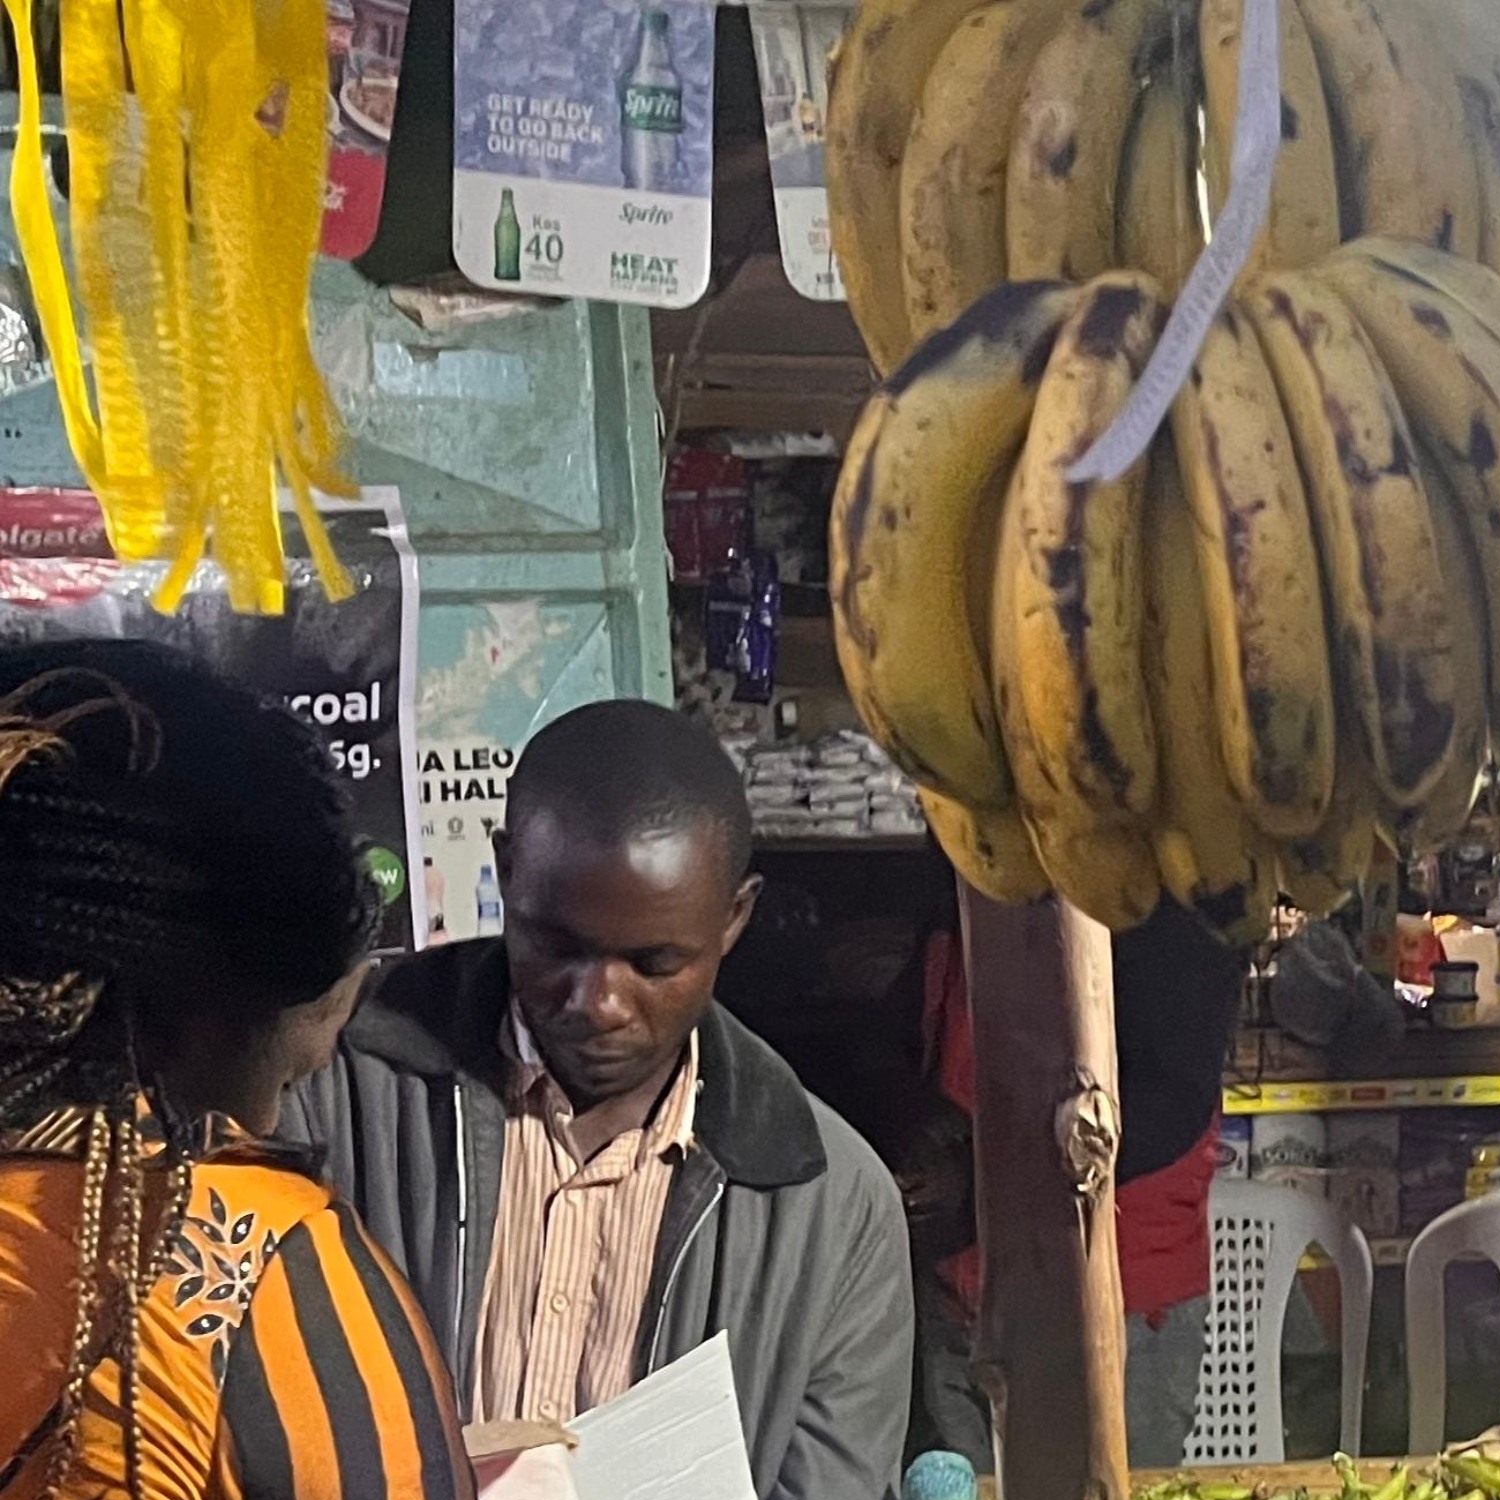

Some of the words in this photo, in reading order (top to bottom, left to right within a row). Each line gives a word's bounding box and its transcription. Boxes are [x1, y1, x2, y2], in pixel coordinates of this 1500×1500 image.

[487, 93, 526, 113] GET
[530, 97, 594, 121] READY
[625, 88, 679, 119] Sprite
[488, 115, 514, 134] TO
[518, 118, 547, 138] GO
[551, 121, 603, 144] BACK
[487, 134, 572, 161] OUTSIDE
[619, 202, 674, 224] Sprite
[524, 233, 564, 263] 40
[611, 251, 679, 274] HEAT
[417, 748, 445, 773] A
[454, 747, 515, 772] LEO
